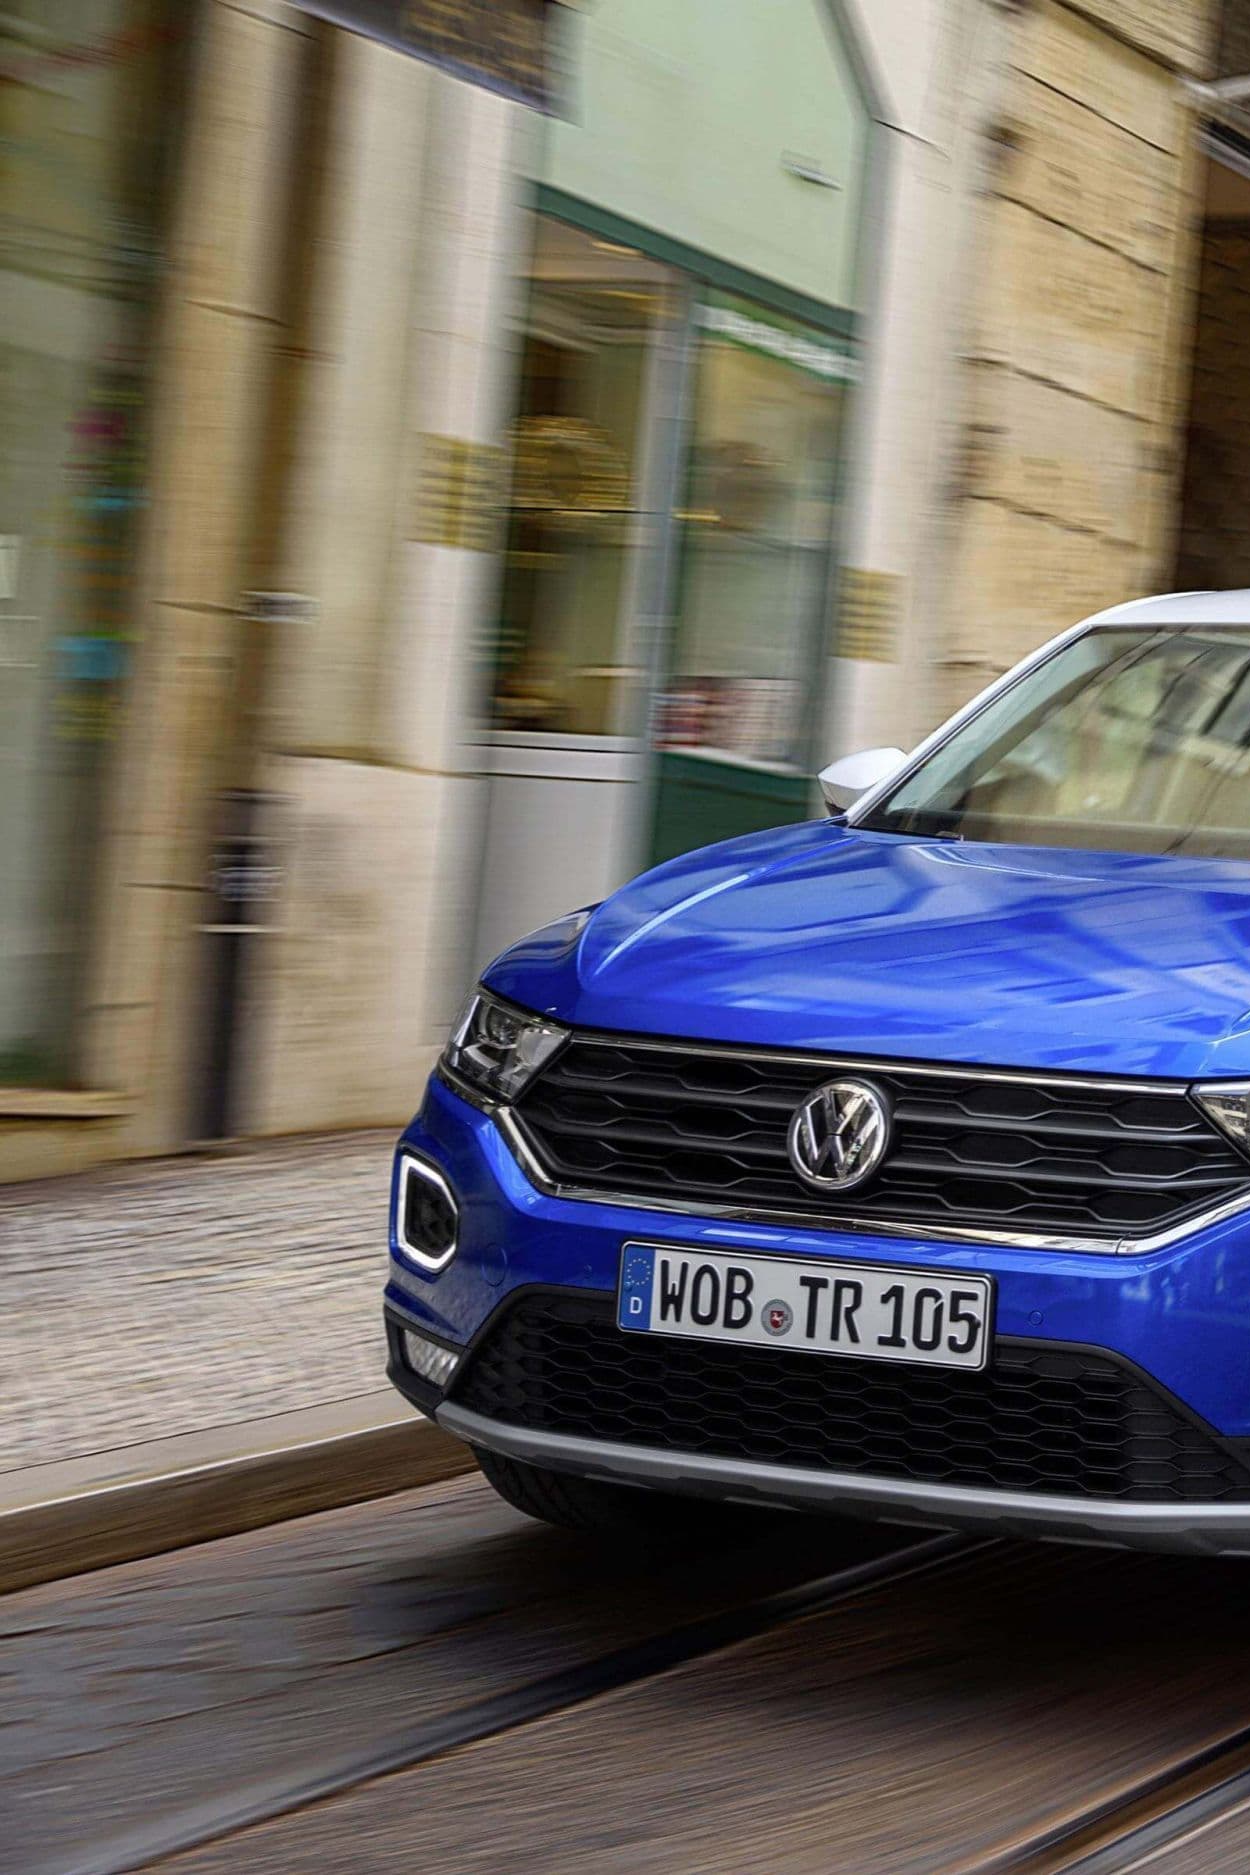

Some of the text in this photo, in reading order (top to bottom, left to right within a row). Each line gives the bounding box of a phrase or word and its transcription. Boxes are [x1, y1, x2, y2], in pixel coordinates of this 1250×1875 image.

[629, 1296, 643, 1315] D
[660, 1258, 981, 1354] WOB TR 105
